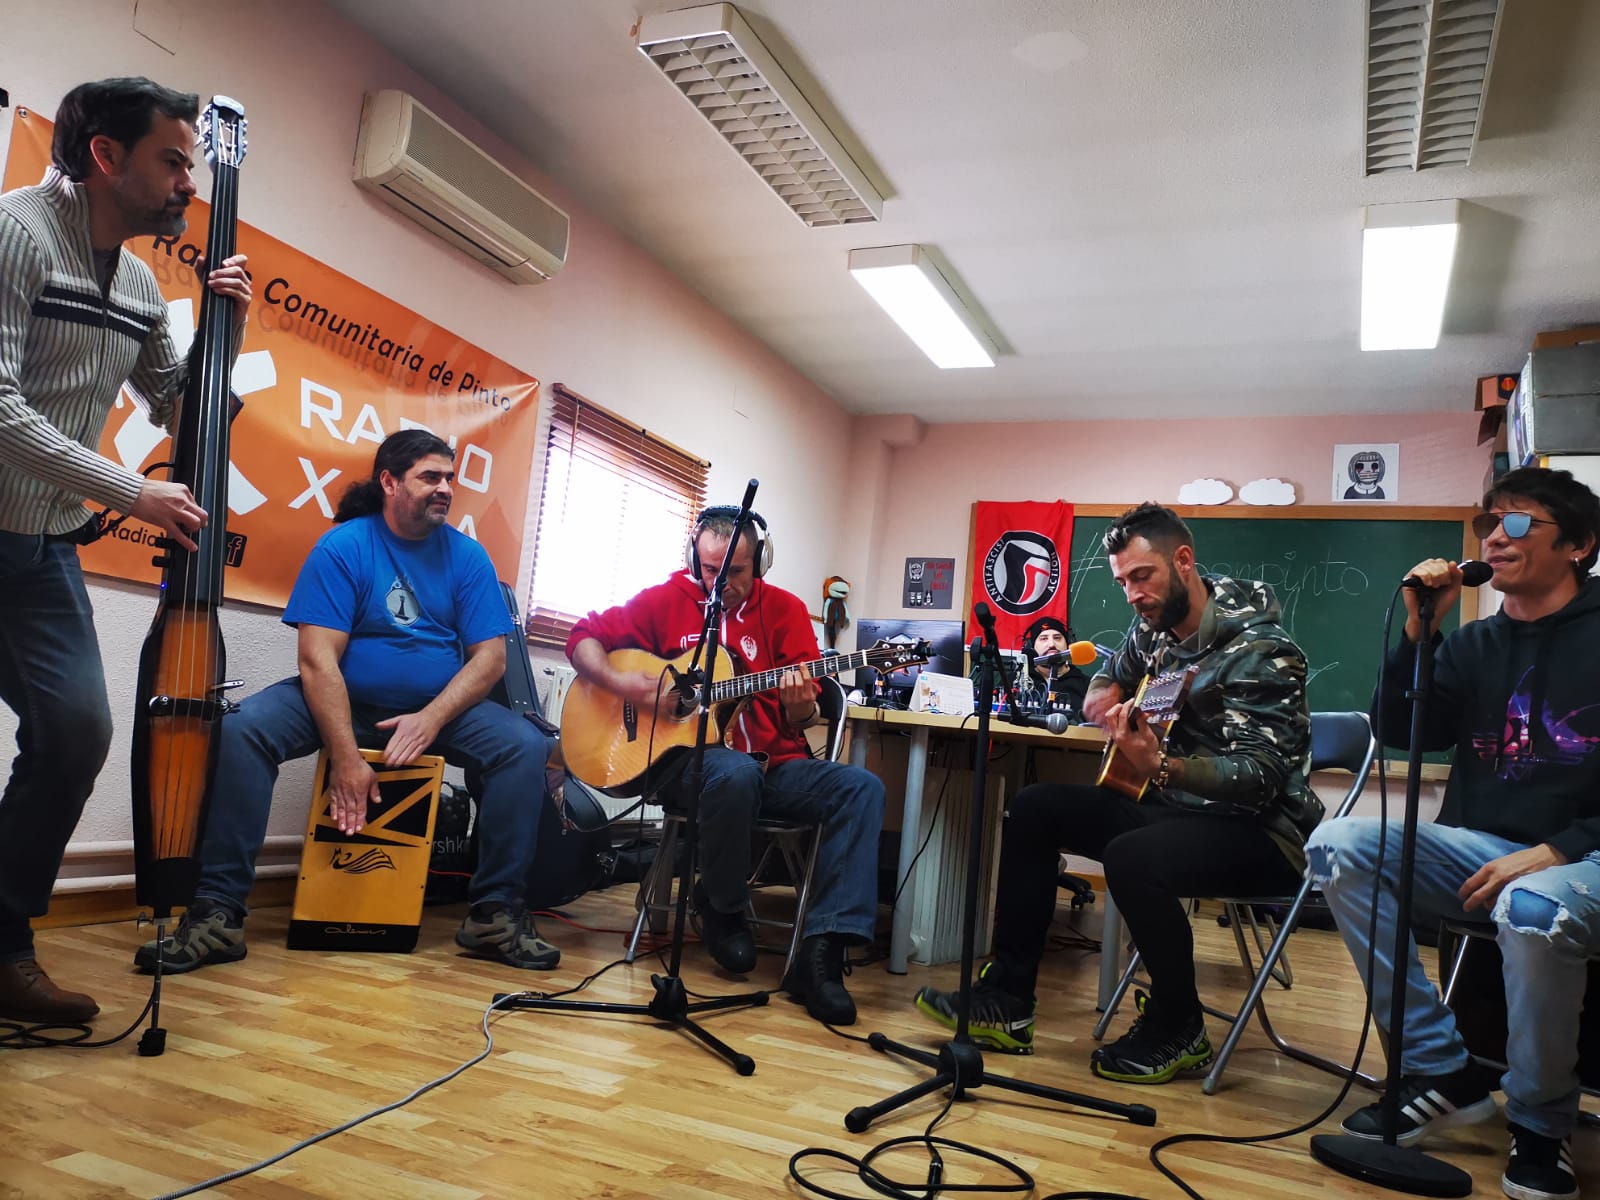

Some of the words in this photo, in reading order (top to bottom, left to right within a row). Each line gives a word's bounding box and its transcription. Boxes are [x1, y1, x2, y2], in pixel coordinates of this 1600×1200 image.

[264, 278, 424, 372] Comunitaria
[429, 361, 454, 386] de
[458, 372, 512, 411] Pinto
[301, 377, 493, 493] RAO
